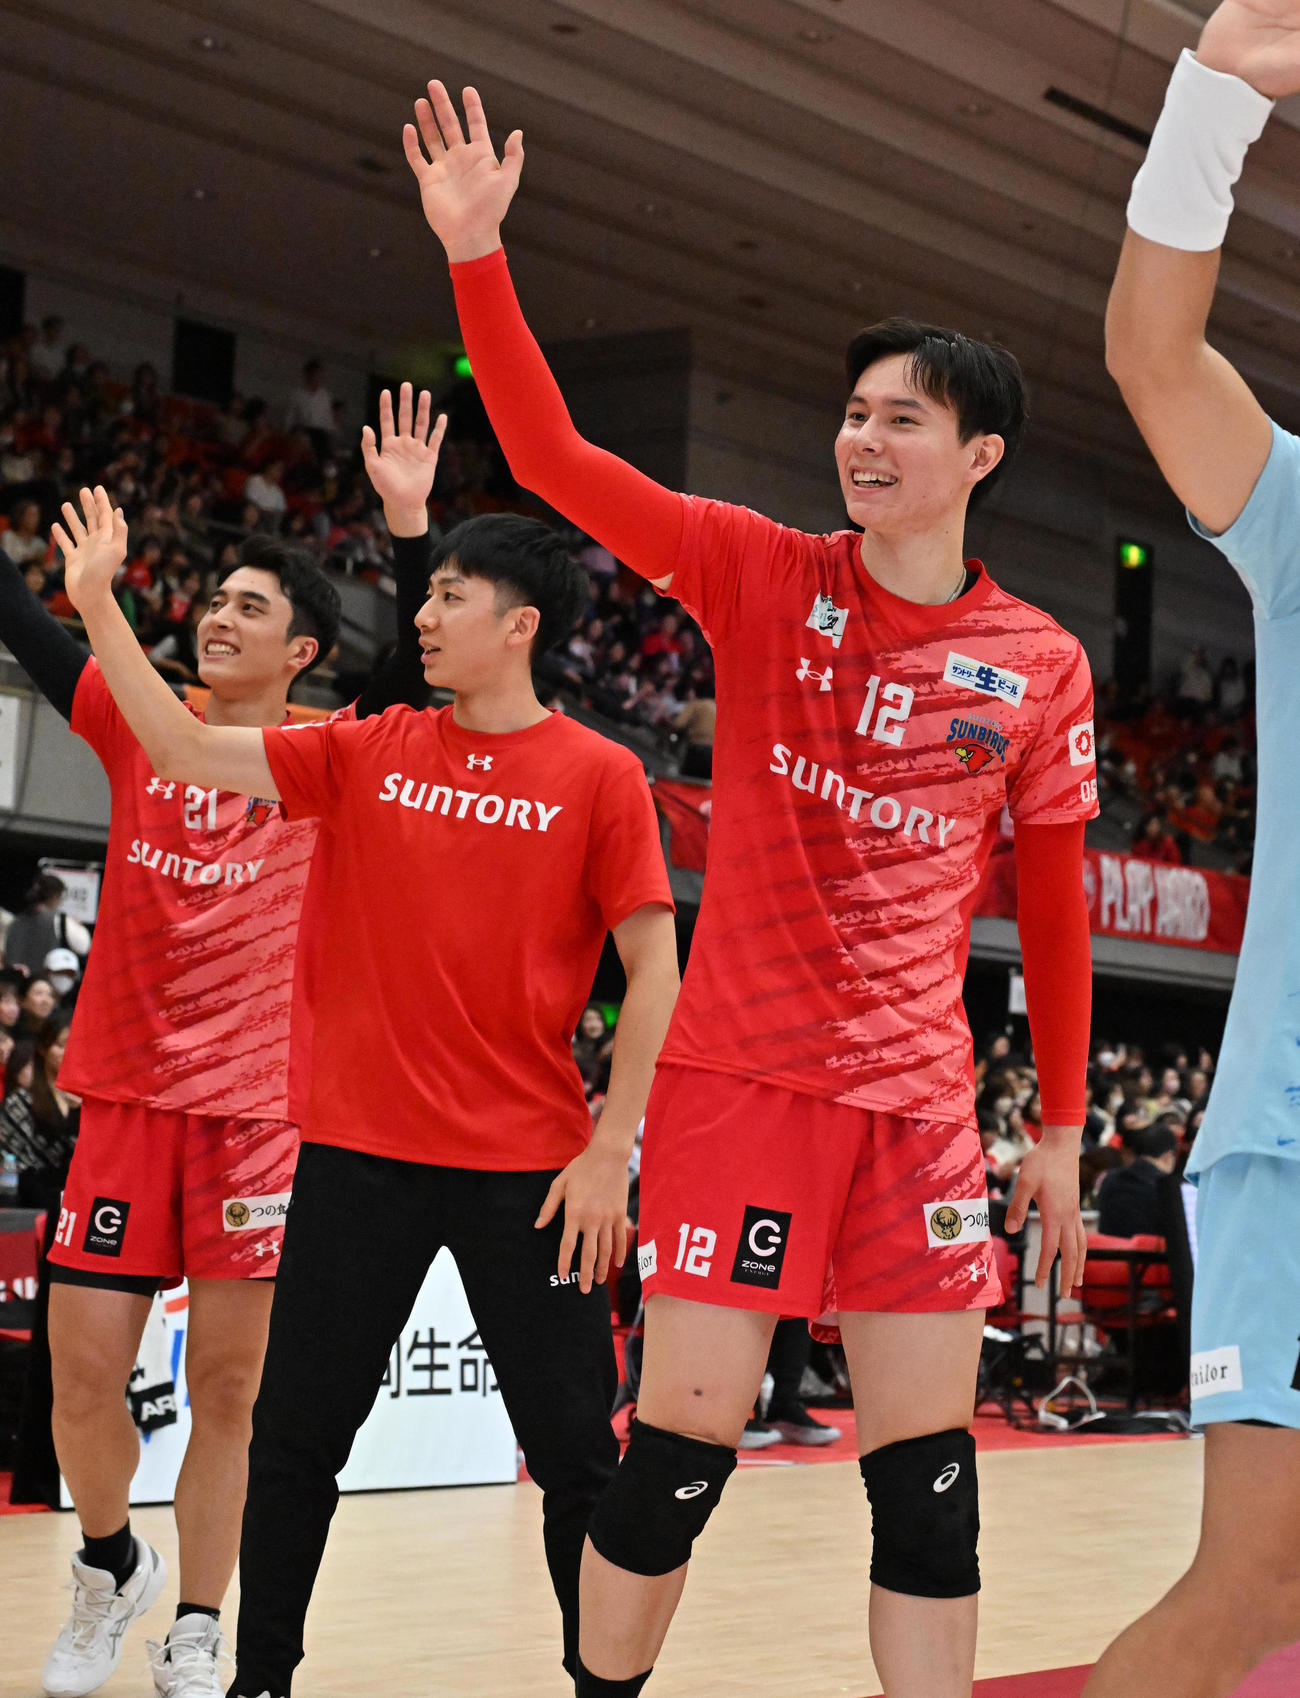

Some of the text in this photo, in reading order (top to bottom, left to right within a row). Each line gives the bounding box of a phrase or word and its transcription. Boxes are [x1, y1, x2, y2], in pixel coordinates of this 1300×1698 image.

[855, 675, 914, 747] 12
[184, 784, 218, 830] 21
[378, 772, 563, 832] SUNTORY
[769, 743, 957, 847] SUNTORY
[127, 839, 265, 885] SUNTORY
[55, 1207, 77, 1247] 21
[673, 1222, 717, 1278] 12
